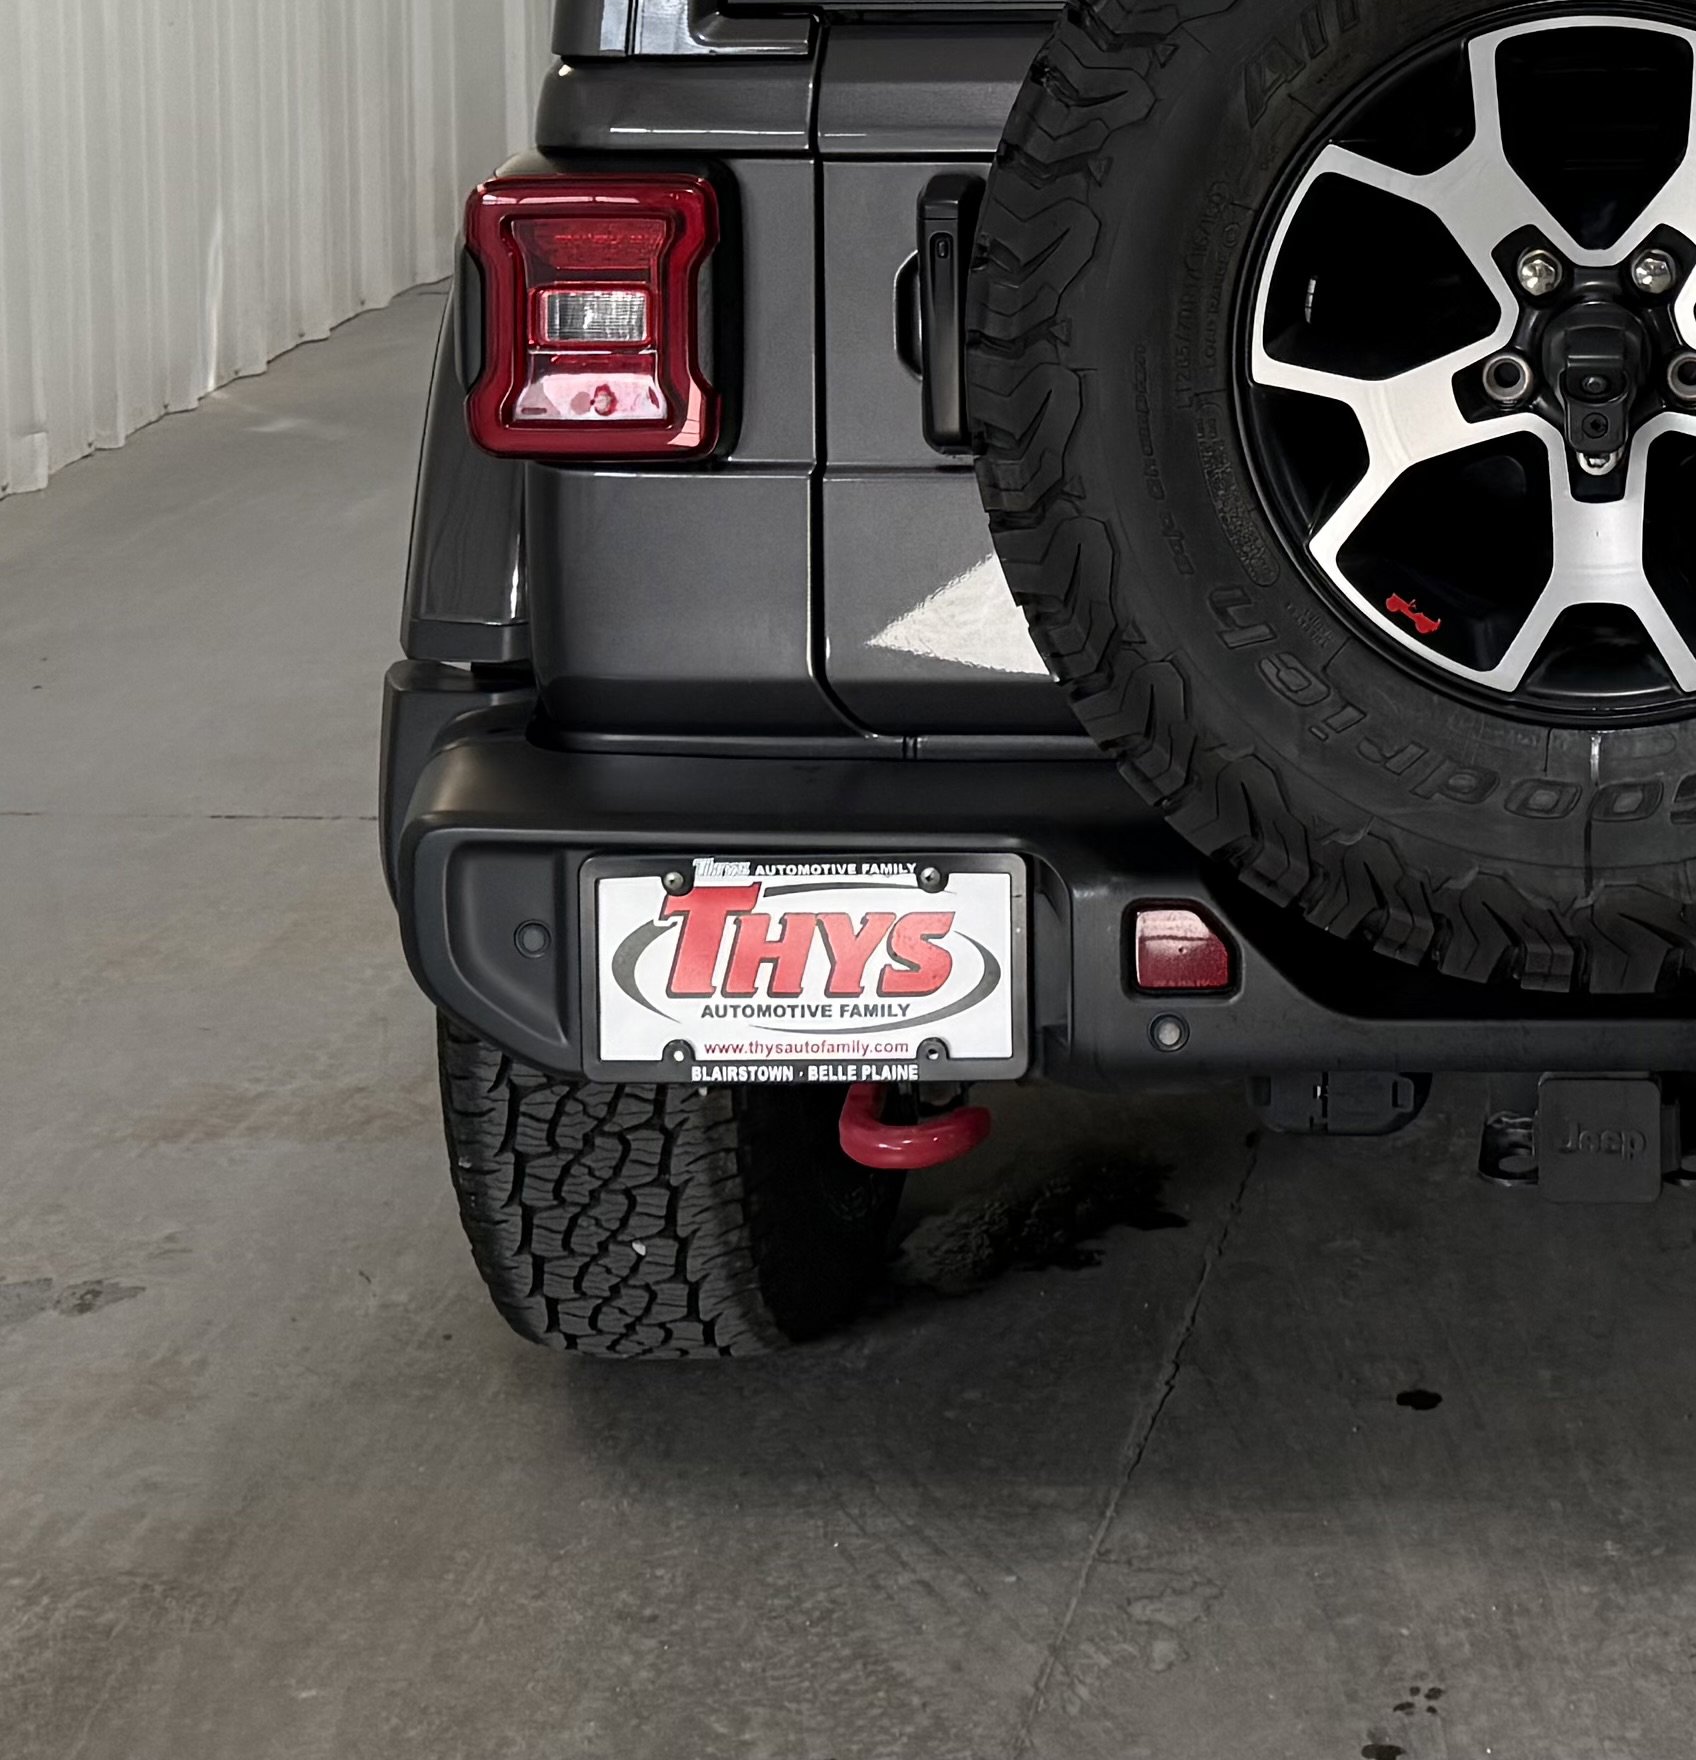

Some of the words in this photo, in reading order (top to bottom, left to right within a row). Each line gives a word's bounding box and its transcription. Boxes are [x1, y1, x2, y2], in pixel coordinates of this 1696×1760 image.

[754, 863, 858, 877] AUTOMOTIVE
[861, 862, 917, 876] FAMILY
[700, 1003, 833, 1019] AUTOMOTIVE
[839, 1002, 911, 1018] FAMILY
[703, 1039, 909, 1058] www.thysautofamily.com
[690, 1065, 794, 1082] BLAIRSTOWN
[807, 1064, 857, 1082] BELLE
[861, 1064, 919, 1082] PLAINE
